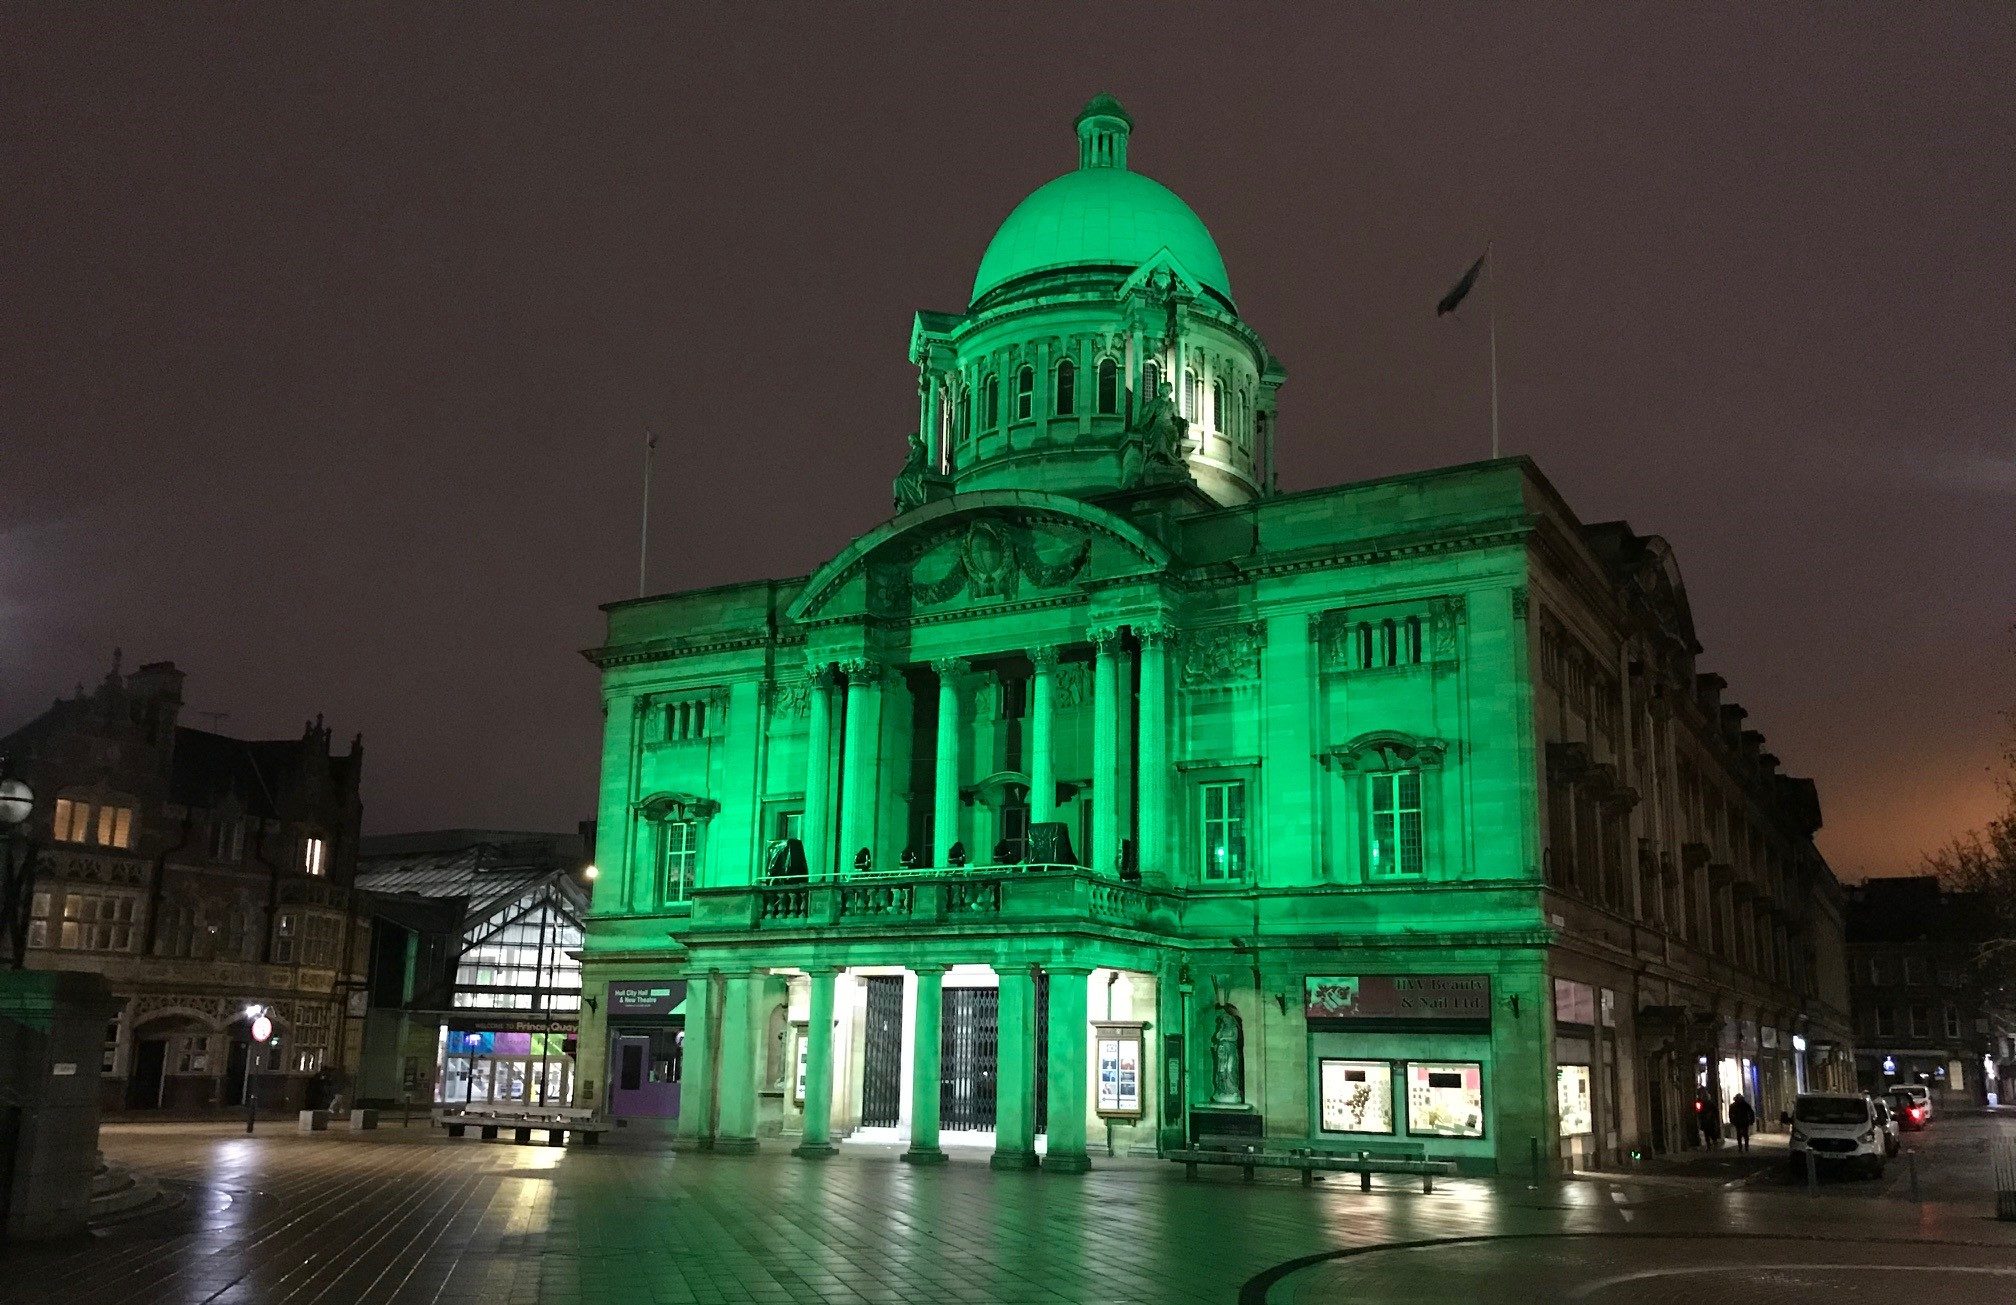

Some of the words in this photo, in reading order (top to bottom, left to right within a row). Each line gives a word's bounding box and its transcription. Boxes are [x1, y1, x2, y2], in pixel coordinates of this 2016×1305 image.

[1431, 979, 1483, 991] Beauty
[1401, 997, 1414, 1008] &
[1418, 997, 1448, 1008] Nail
[551, 1022, 578, 1032] Quay
